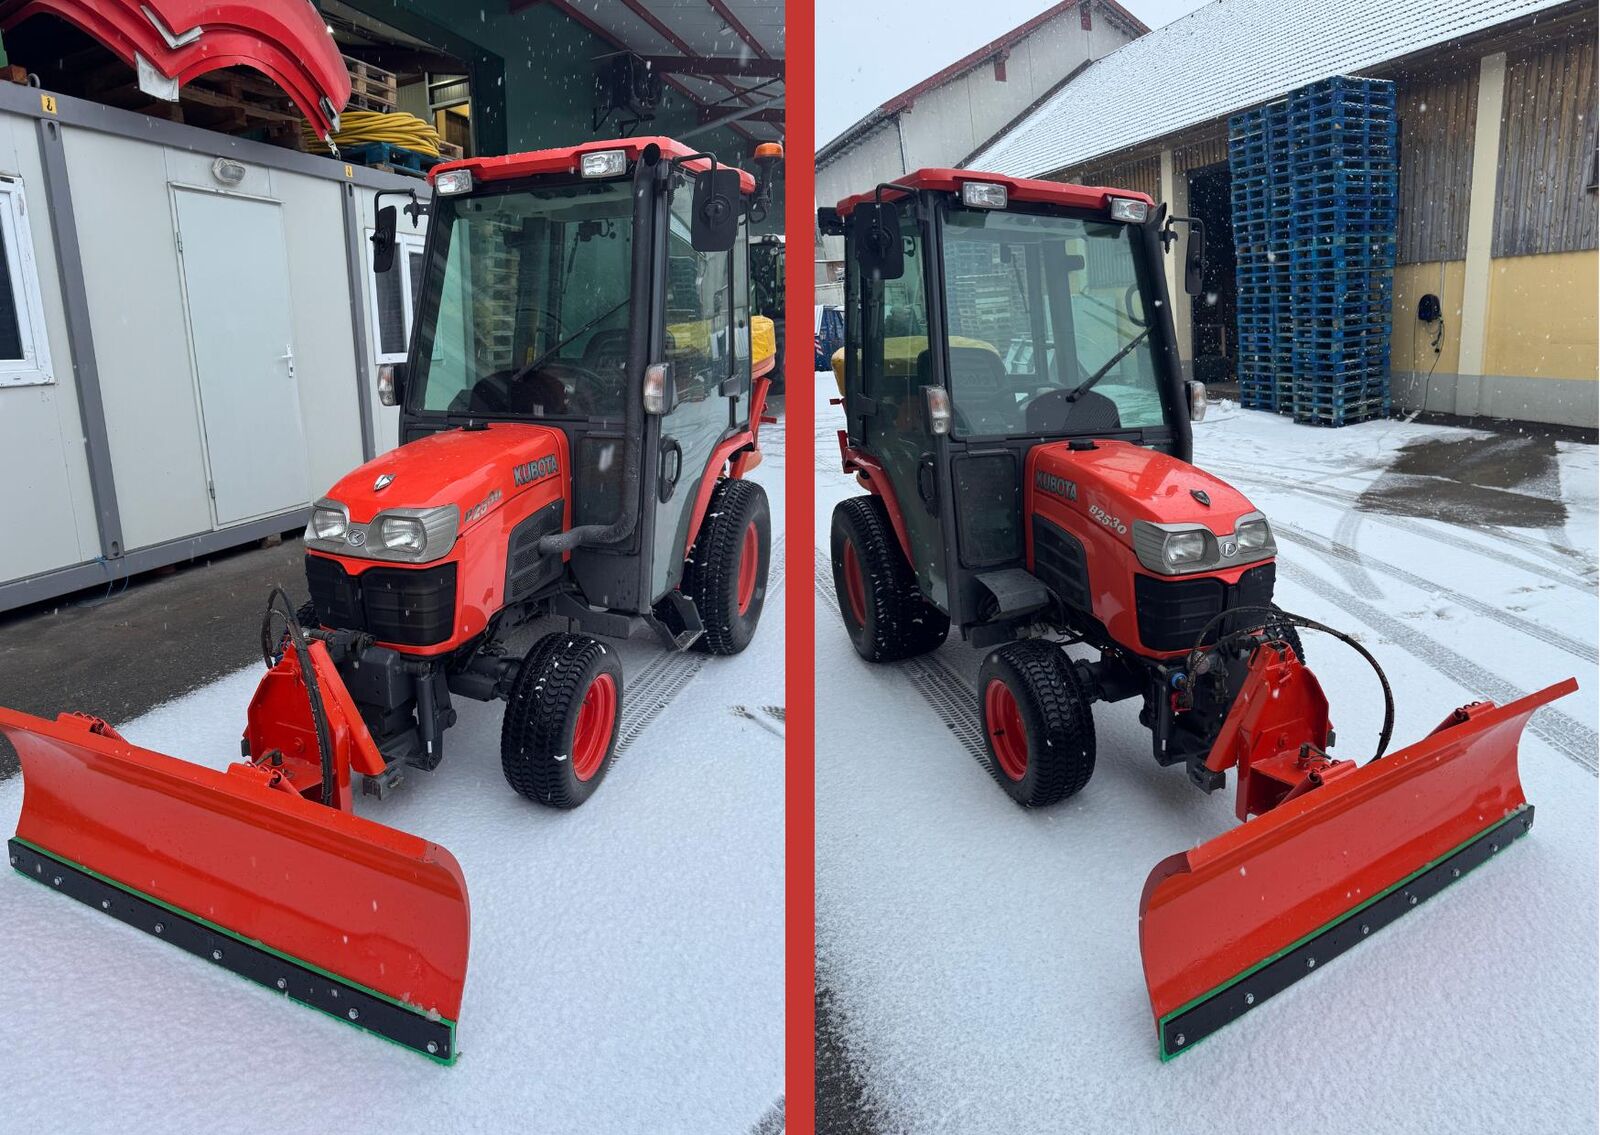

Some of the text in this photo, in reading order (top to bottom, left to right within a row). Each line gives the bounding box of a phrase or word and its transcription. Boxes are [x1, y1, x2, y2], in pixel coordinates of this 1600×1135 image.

[513, 454, 558, 487] KUBOTA
[1036, 468, 1077, 501] KUBOTA
[1089, 504, 1127, 534] B2530
